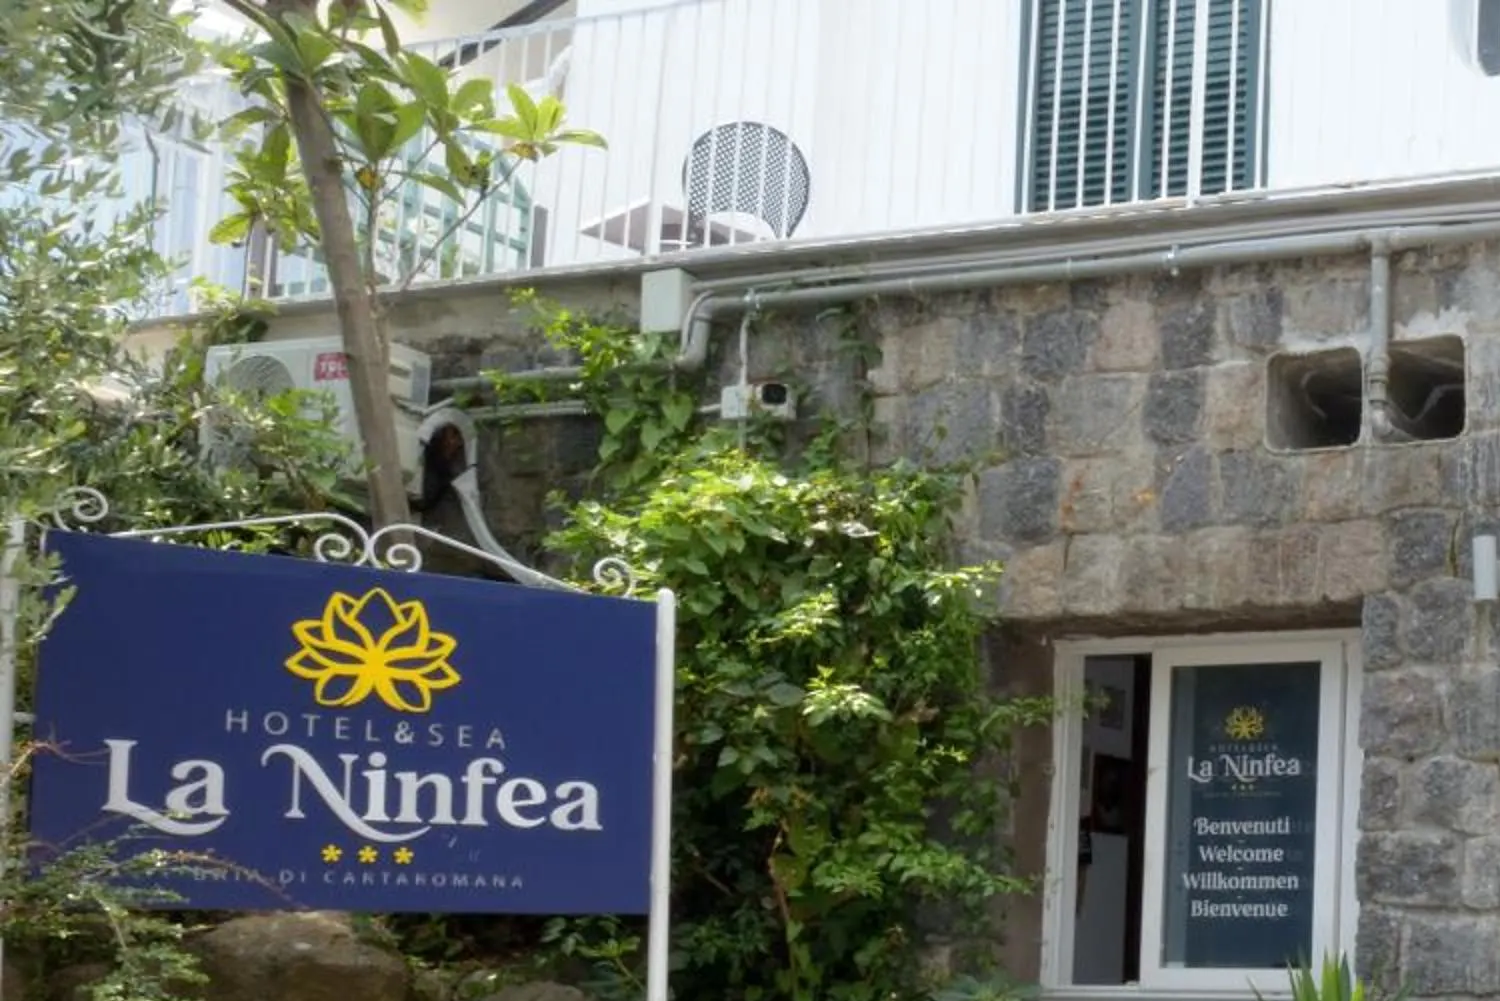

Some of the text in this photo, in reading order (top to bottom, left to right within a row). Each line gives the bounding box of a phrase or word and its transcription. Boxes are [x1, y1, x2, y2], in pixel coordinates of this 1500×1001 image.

[224, 709, 507, 750] HOTEL&SEA
[1187, 752, 1301, 783] La Ninfea
[101, 738, 604, 843] La Ninfea
[1193, 815, 1291, 836] Benvenuti
[1199, 844, 1284, 863] Welcome
[279, 869, 306, 885] DI
[323, 869, 524, 890] CARTAROMANA
[1182, 871, 1300, 891] Willkommen
[1190, 898, 1289, 918] Bienvenue
